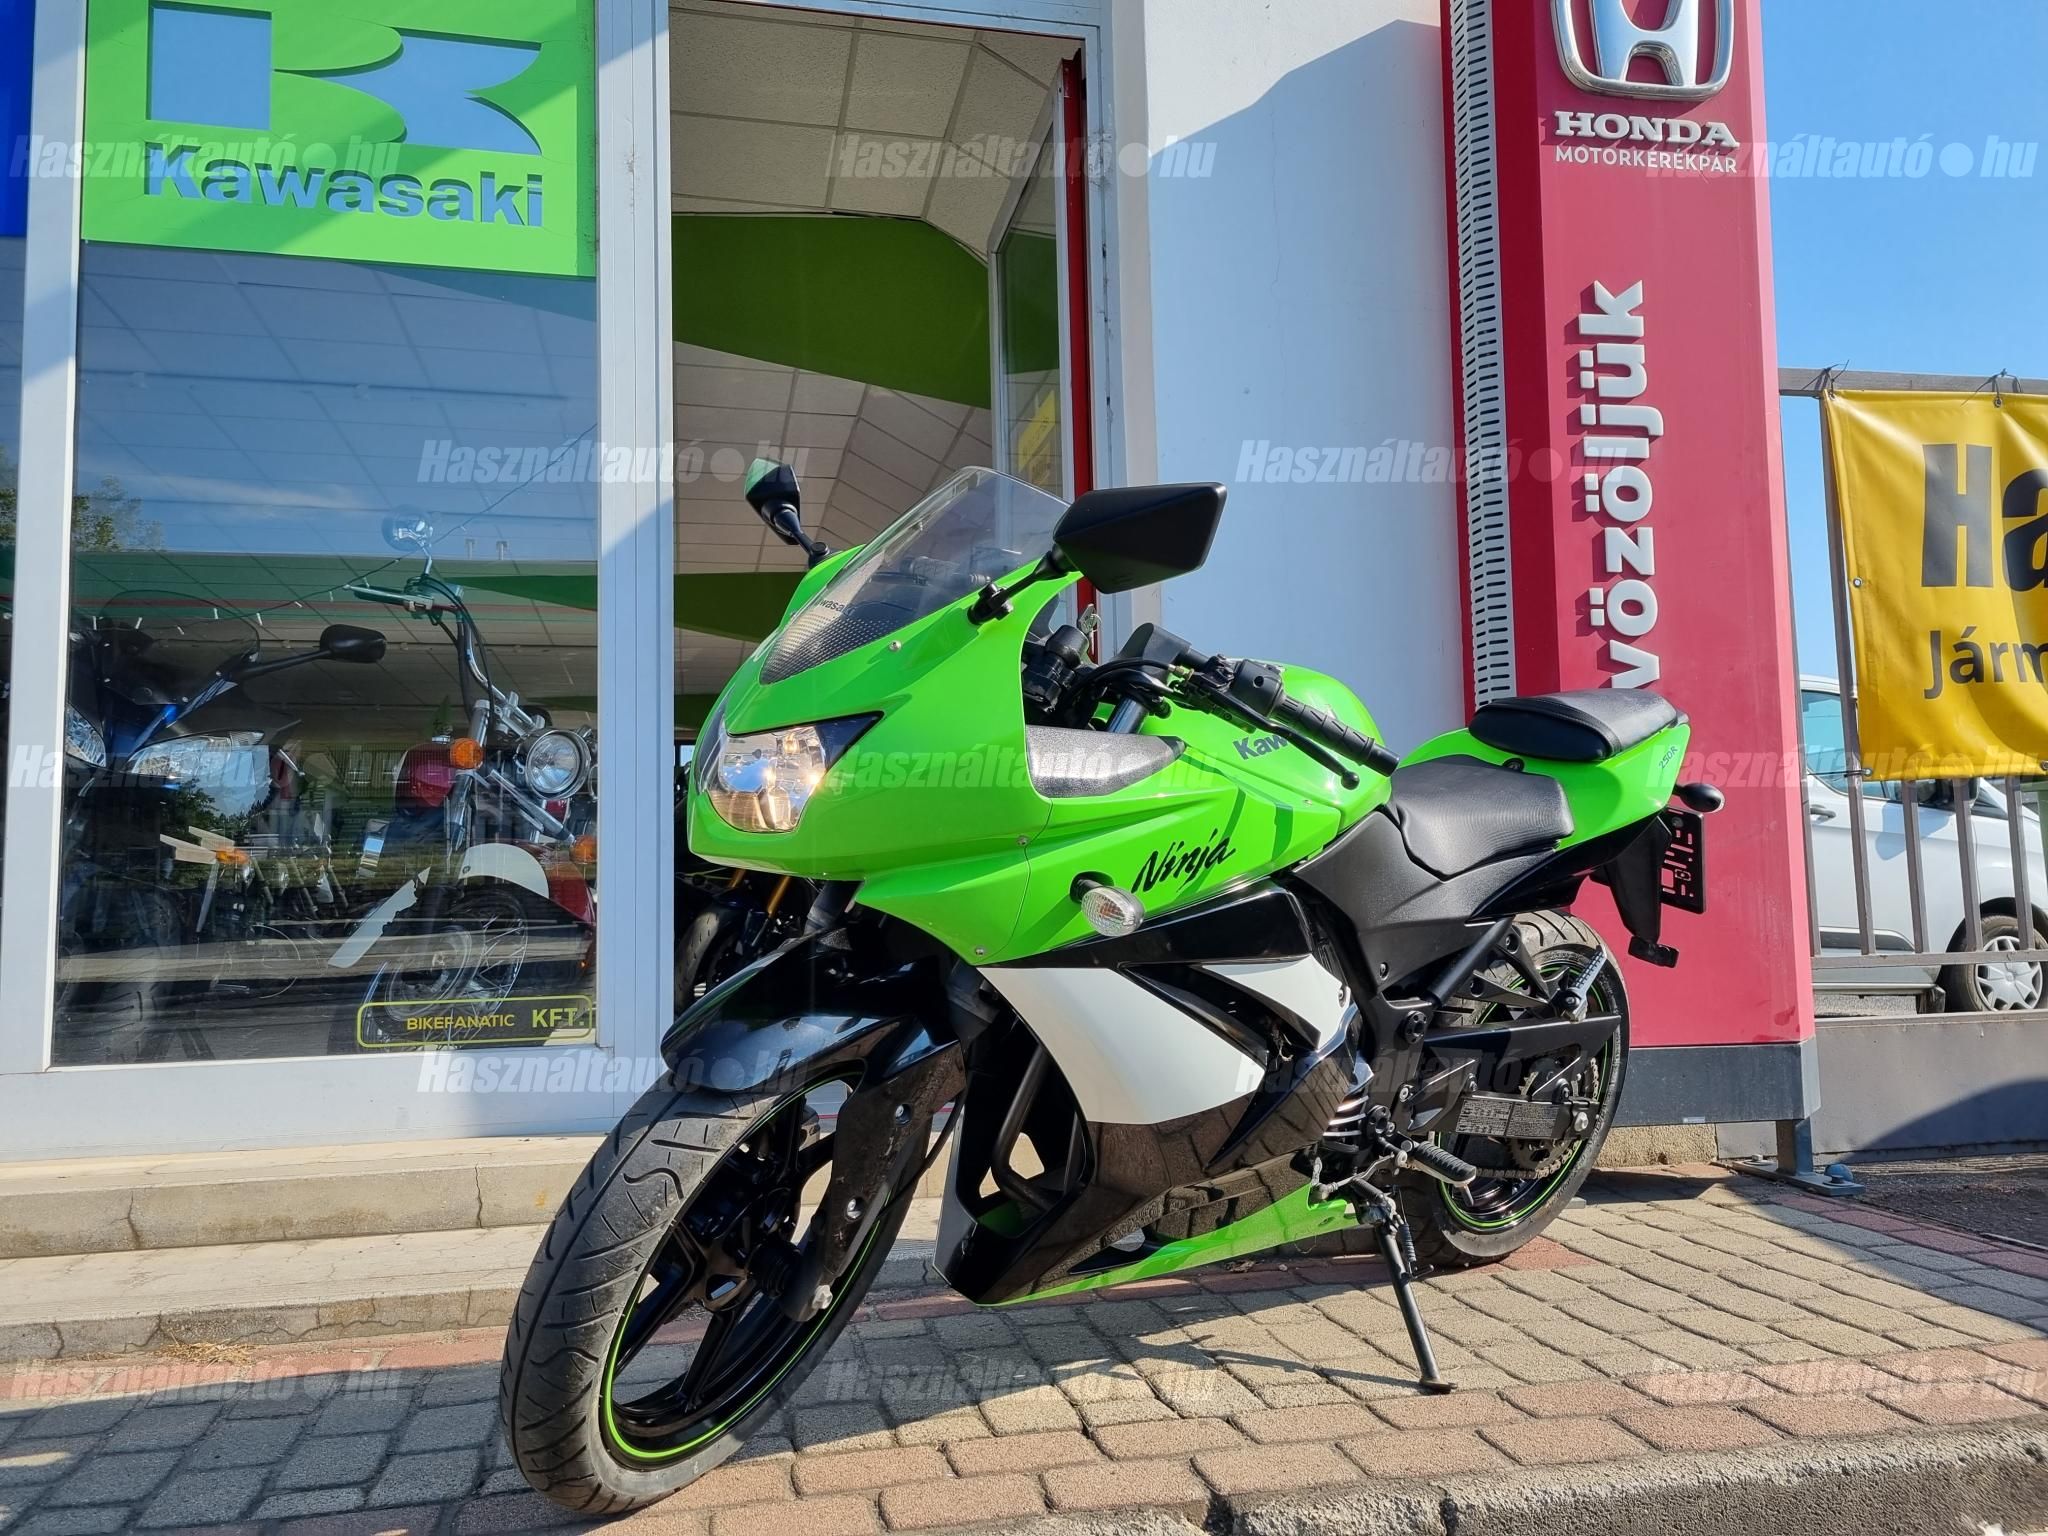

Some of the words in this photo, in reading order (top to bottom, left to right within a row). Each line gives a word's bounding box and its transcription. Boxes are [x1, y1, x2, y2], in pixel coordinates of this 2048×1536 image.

[1554, 110, 1740, 148] HONDA
[1555, 145, 1737, 173] MOTORKERÉKPÁR
[144, 141, 543, 227] Kawasaki
[1130, 828, 1237, 893] Ninja
[406, 1014, 516, 1031] BIKEFANATIC
[531, 1007, 586, 1028] KFT.
